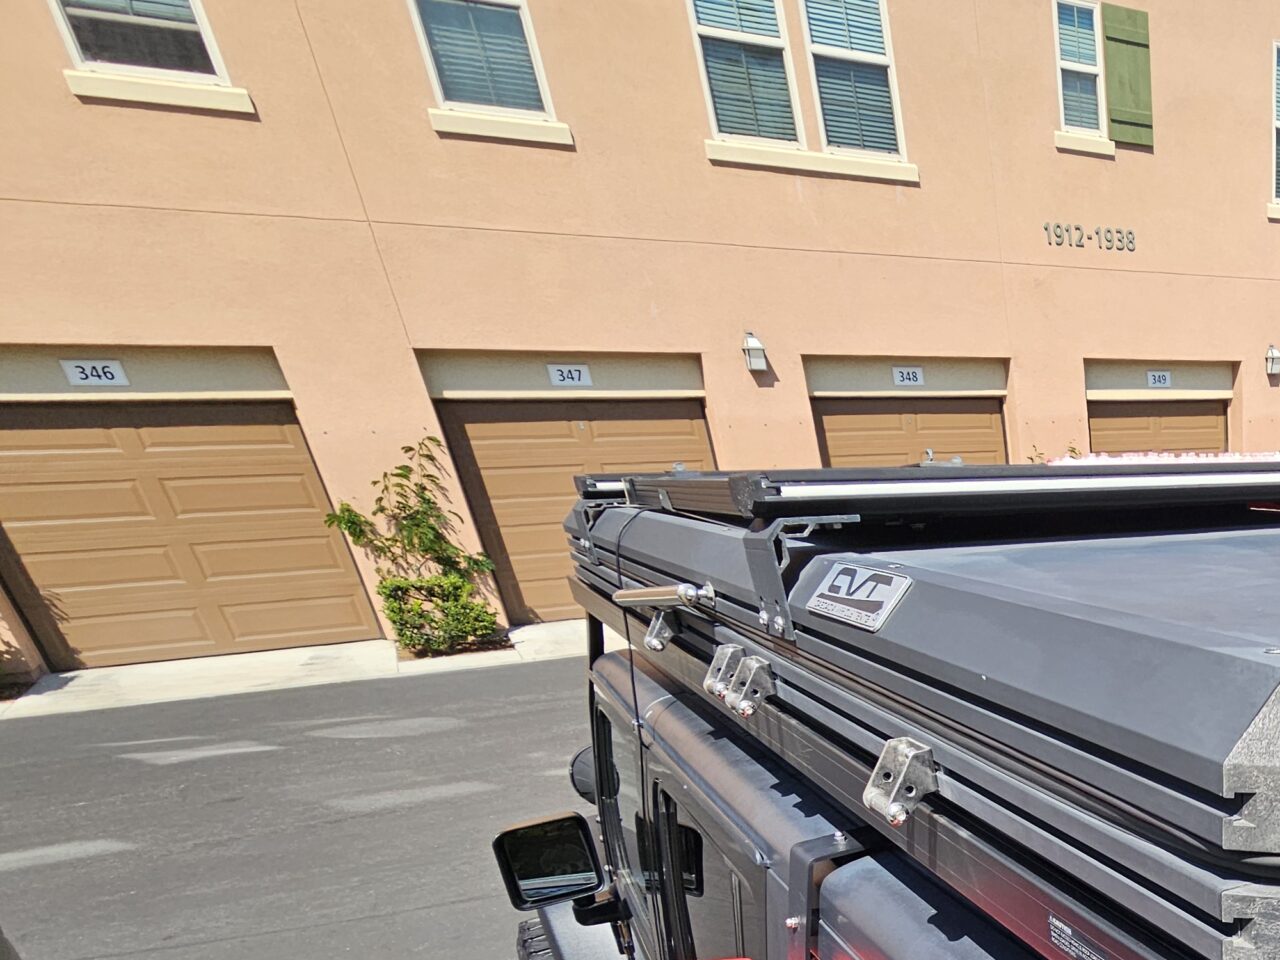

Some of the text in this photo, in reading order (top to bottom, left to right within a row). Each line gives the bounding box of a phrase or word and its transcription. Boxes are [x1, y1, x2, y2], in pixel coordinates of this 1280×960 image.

[1043, 222, 1136, 252] 1912-1938
[74, 365, 115, 381] 346
[556, 369, 582, 382] 347
[898, 370, 919, 382] 348
[1151, 374, 1167, 385] 349
[827, 566, 895, 599] CVT
